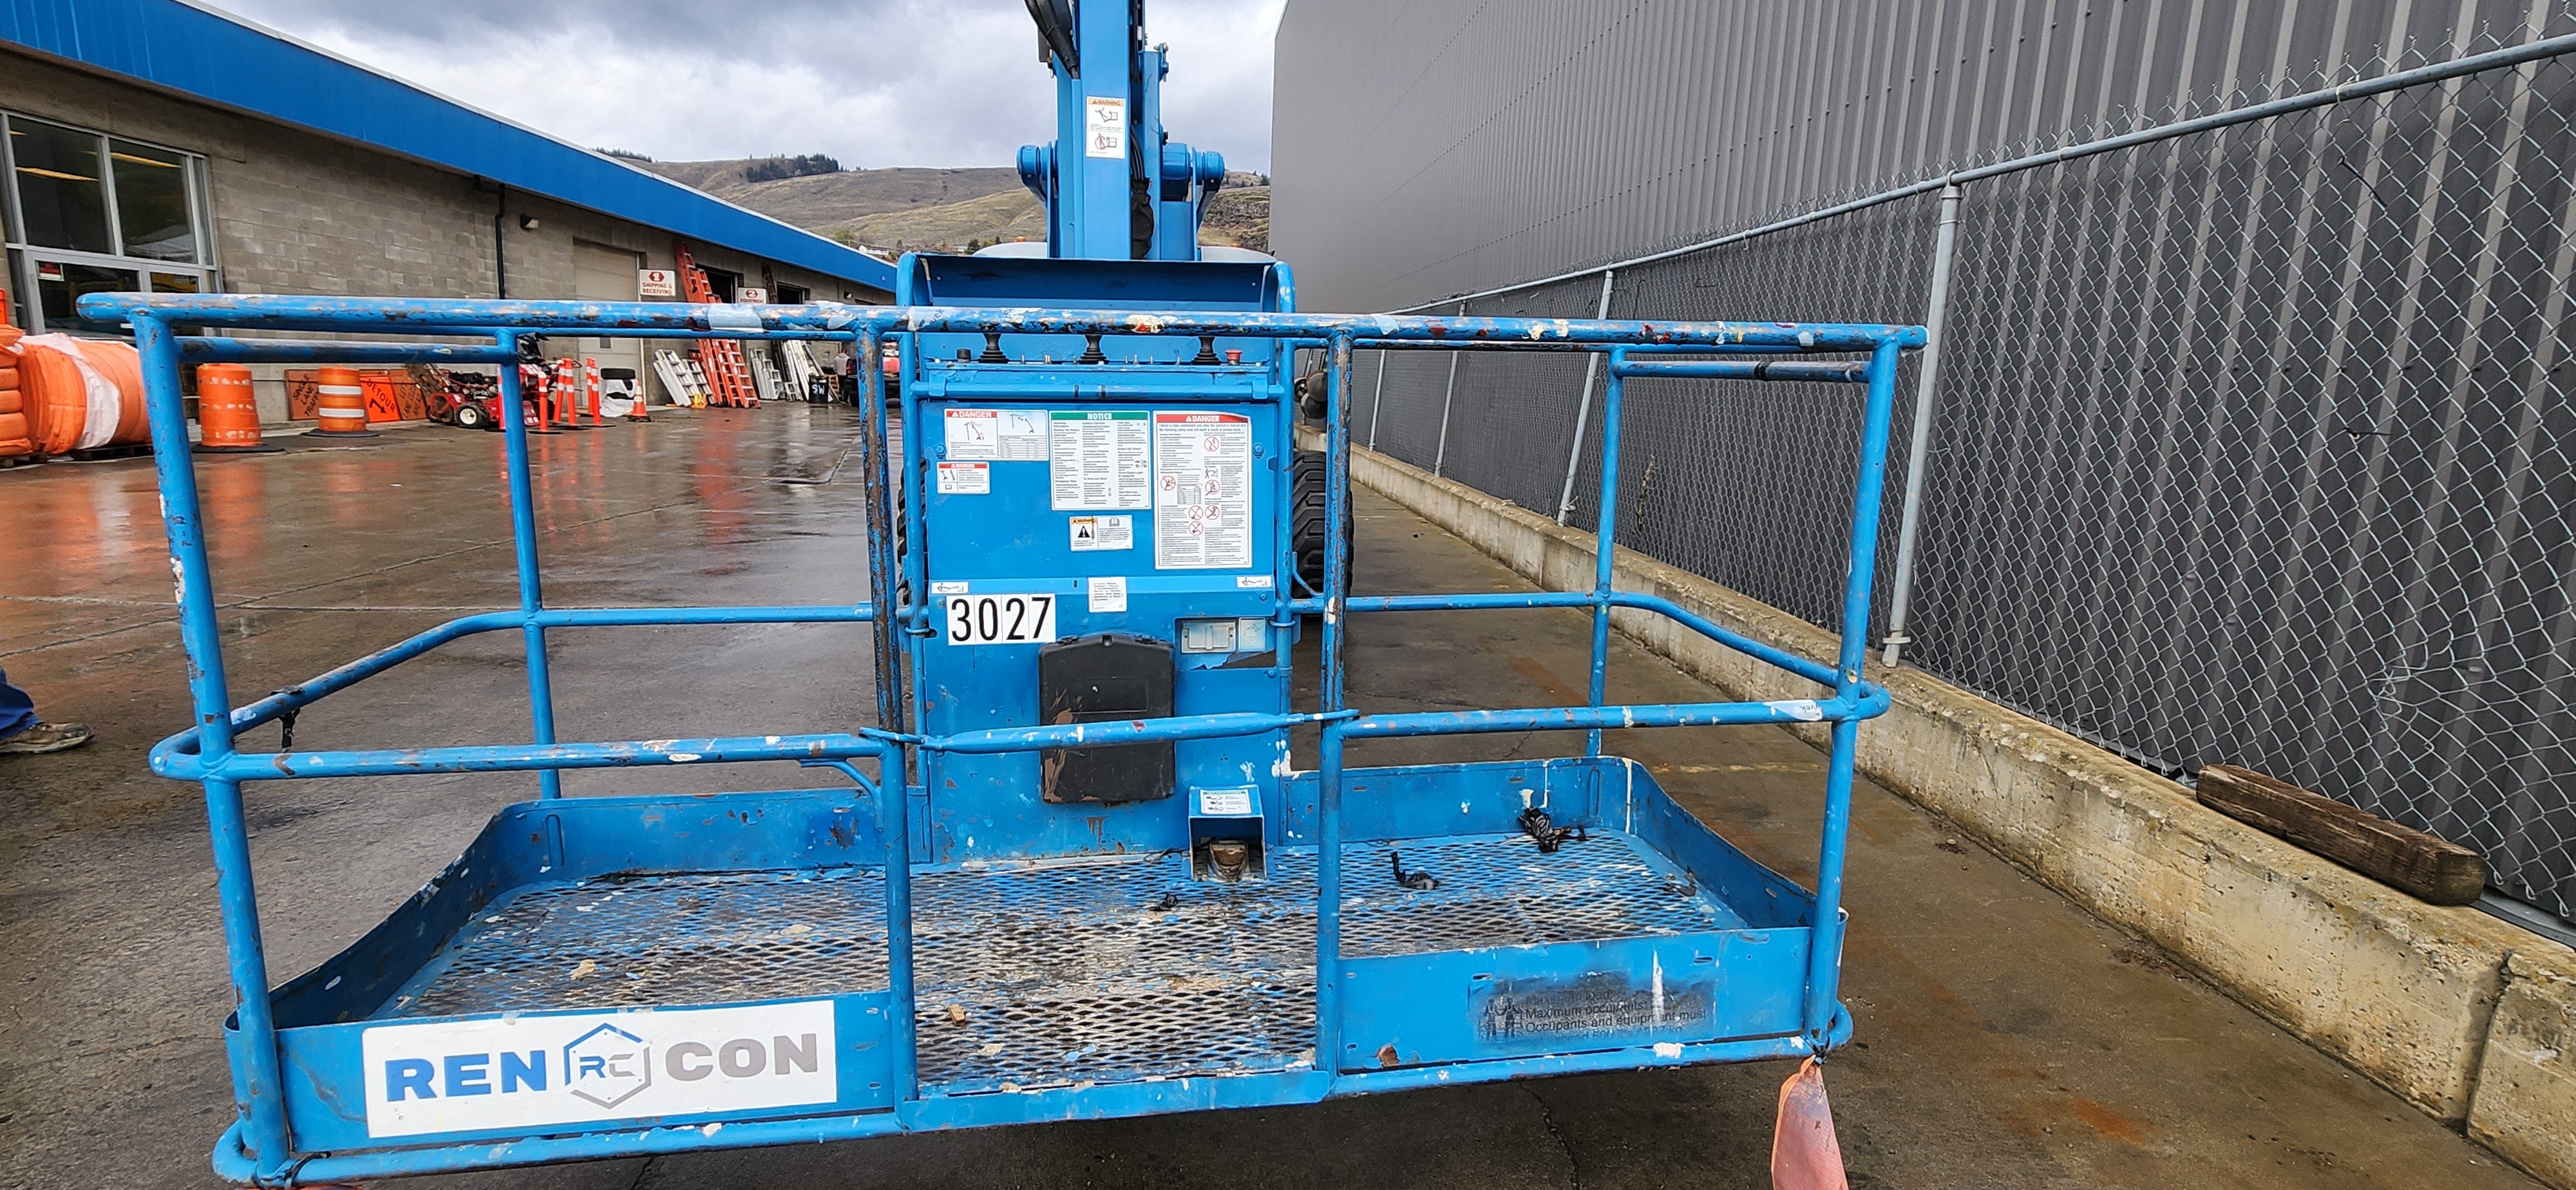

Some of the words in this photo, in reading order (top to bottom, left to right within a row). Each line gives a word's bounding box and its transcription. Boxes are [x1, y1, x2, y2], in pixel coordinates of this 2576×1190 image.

[653, 272, 660, 281] 1
[292, 373, 310, 401] SINGLE
[300, 383, 314, 405] LANE
[366, 379, 396, 413] DETOUR
[811, 384, 825, 394] SW
[304, 387, 320, 417] TRAFF
[951, 597, 1052, 641] 3027
[1525, 1006, 1582, 1019] Maximum
[1526, 1018, 1588, 1034] Occupants
[1591, 1015, 1613, 1028] and
[1680, 1010, 1707, 1021] must
[384, 1050, 547, 1102] REN
[580, 1053, 635, 1079] RC
[665, 1034, 819, 1082] CON
